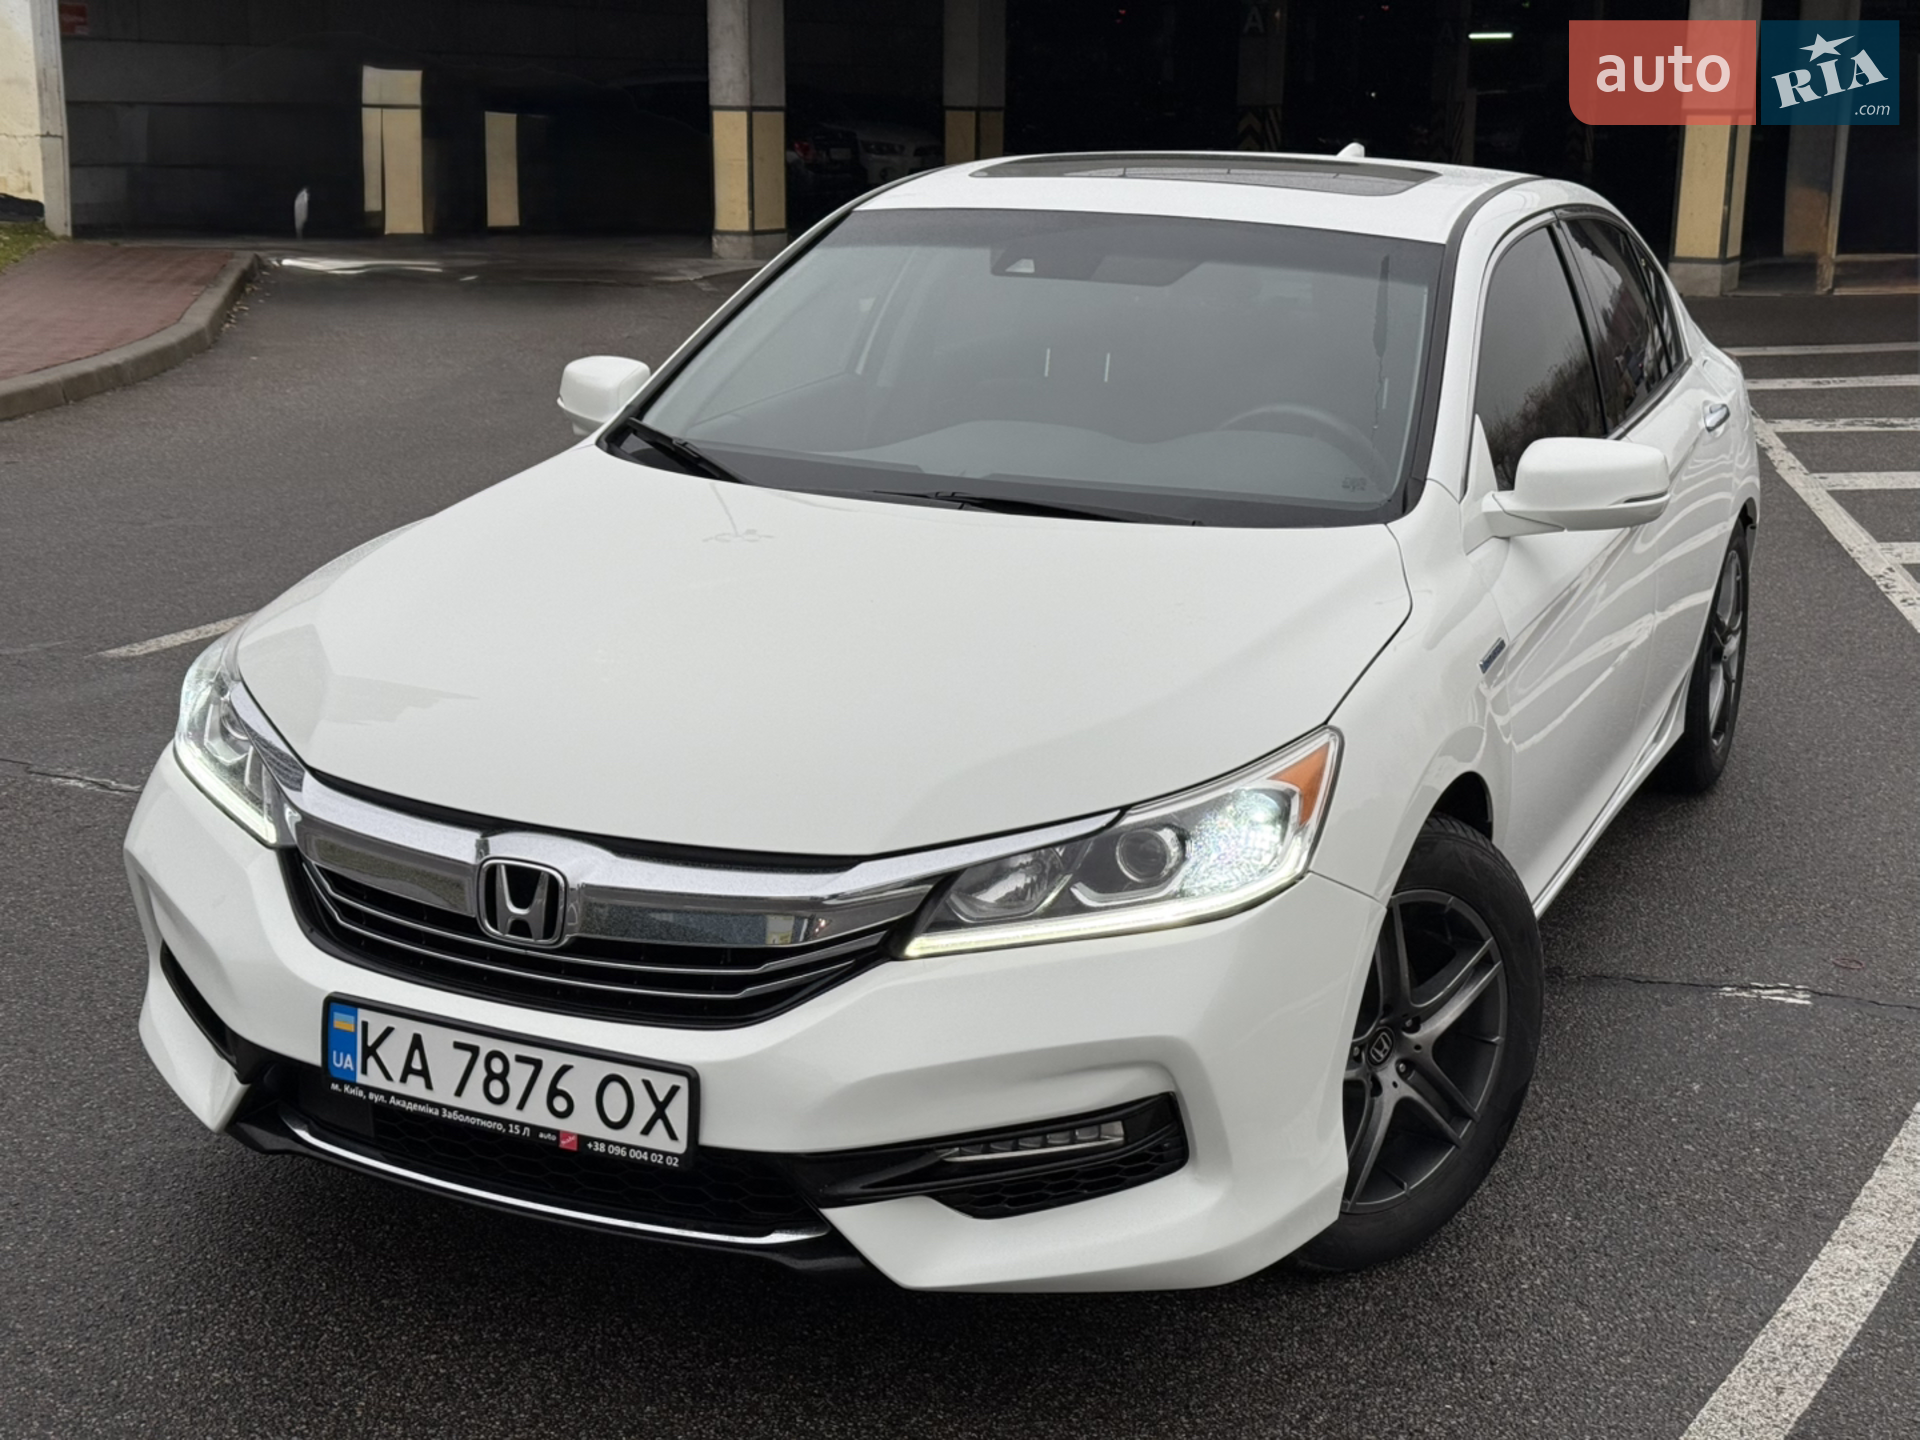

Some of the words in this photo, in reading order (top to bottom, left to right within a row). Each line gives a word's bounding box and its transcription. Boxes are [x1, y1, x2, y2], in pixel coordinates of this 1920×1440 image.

[332, 1049, 354, 1072] UA
[360, 1020, 435, 1092] KA
[452, 1040, 575, 1120] 7876
[595, 1073, 682, 1142] OX
[330, 1083, 341, 1092] м.
[343, 1084, 367, 1099] Київ,
[368, 1092, 388, 1105] вул.
[389, 1095, 440, 1117] Академіка
[441, 1107, 506, 1134] Заболотного,
[508, 1123, 521, 1136] 15
[586, 1140, 606, 1154] +38
[607, 1143, 628, 1158] 096
[628, 1148, 649, 1162] 004
[650, 1152, 664, 1165] 02
[665, 1155, 680, 1168] 02
